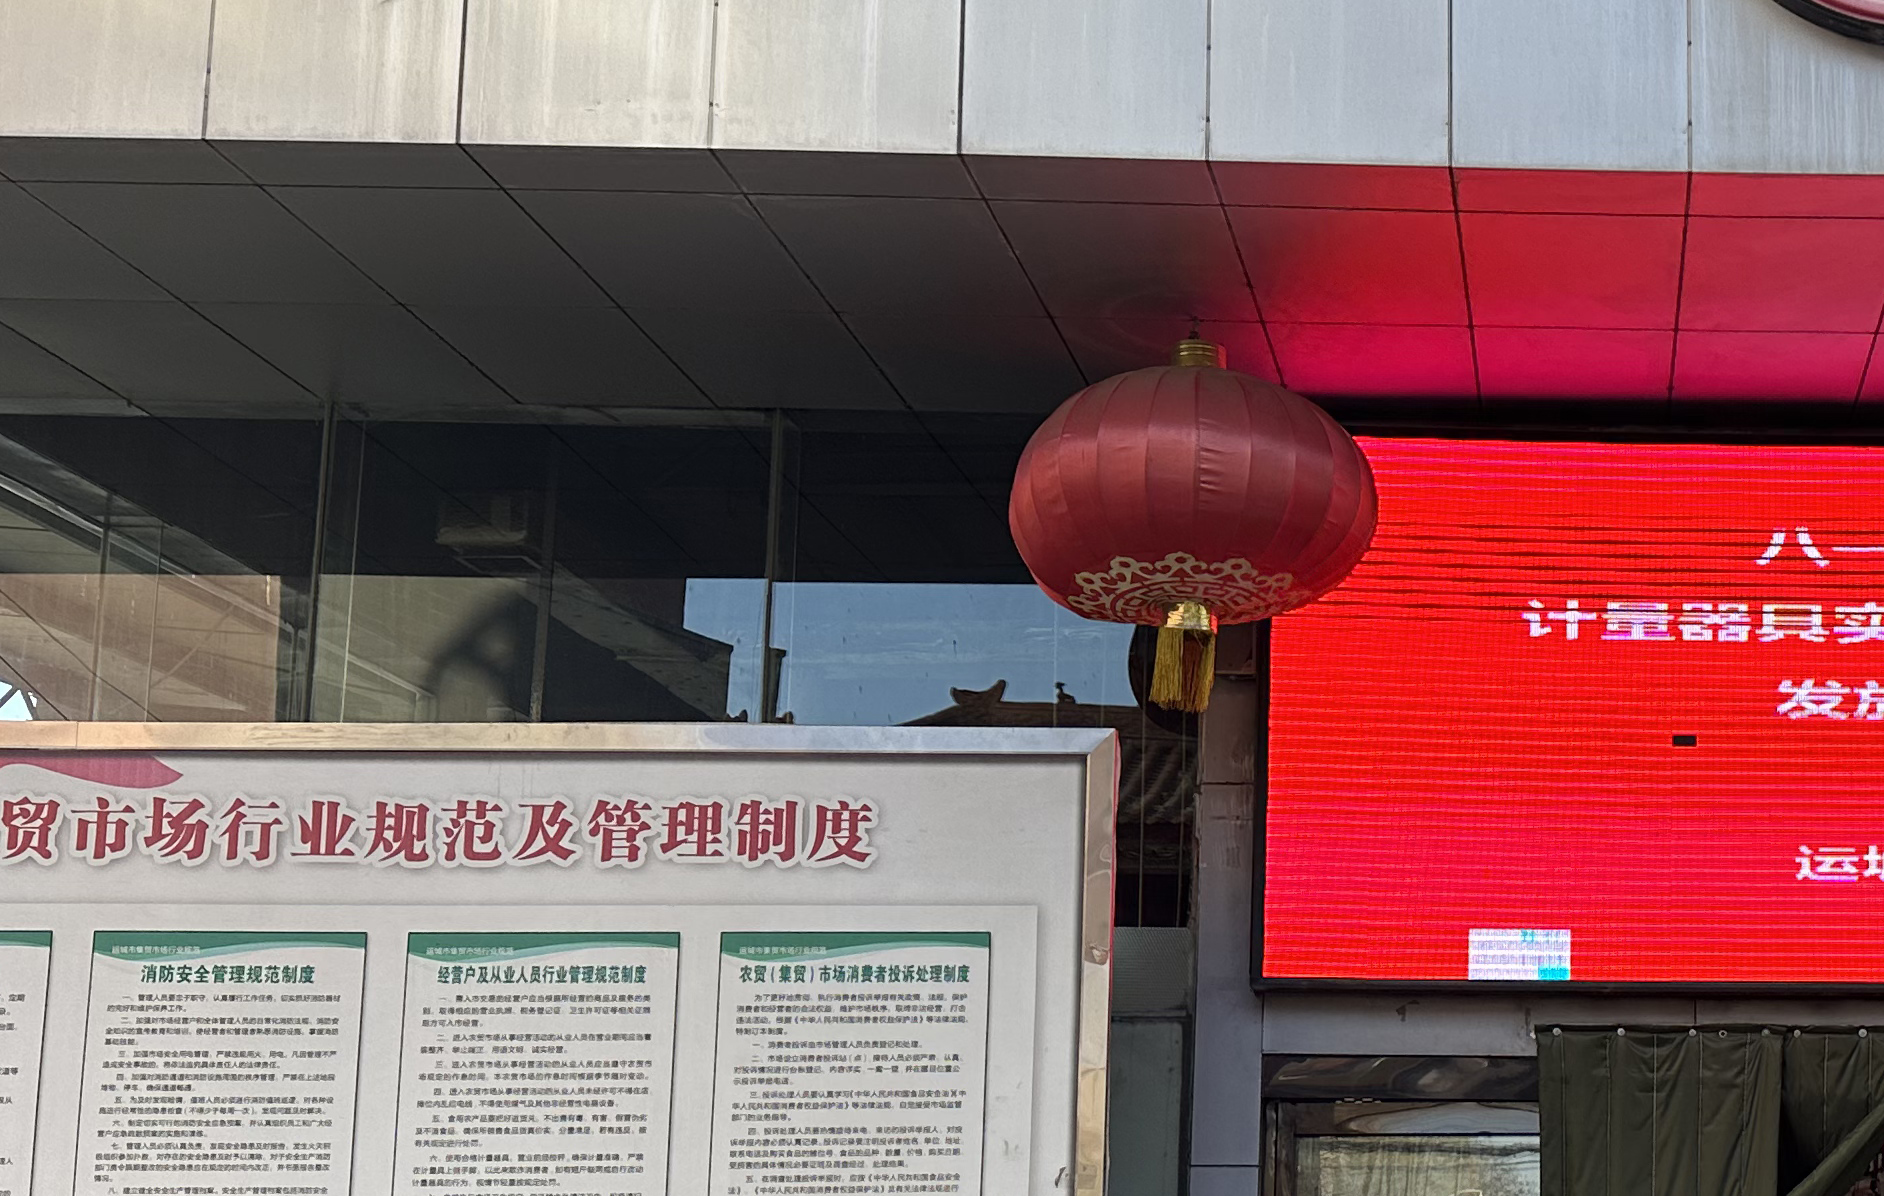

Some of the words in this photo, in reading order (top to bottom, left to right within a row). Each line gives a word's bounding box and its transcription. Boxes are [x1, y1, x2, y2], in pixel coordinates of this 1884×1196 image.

[2, 796, 875, 864] 贸市场行业规范及管理制度
[141, 964, 316, 984] 消防安全管理规范制度
[437, 965, 647, 984] 经营户及从业人员行业管理规范制度
